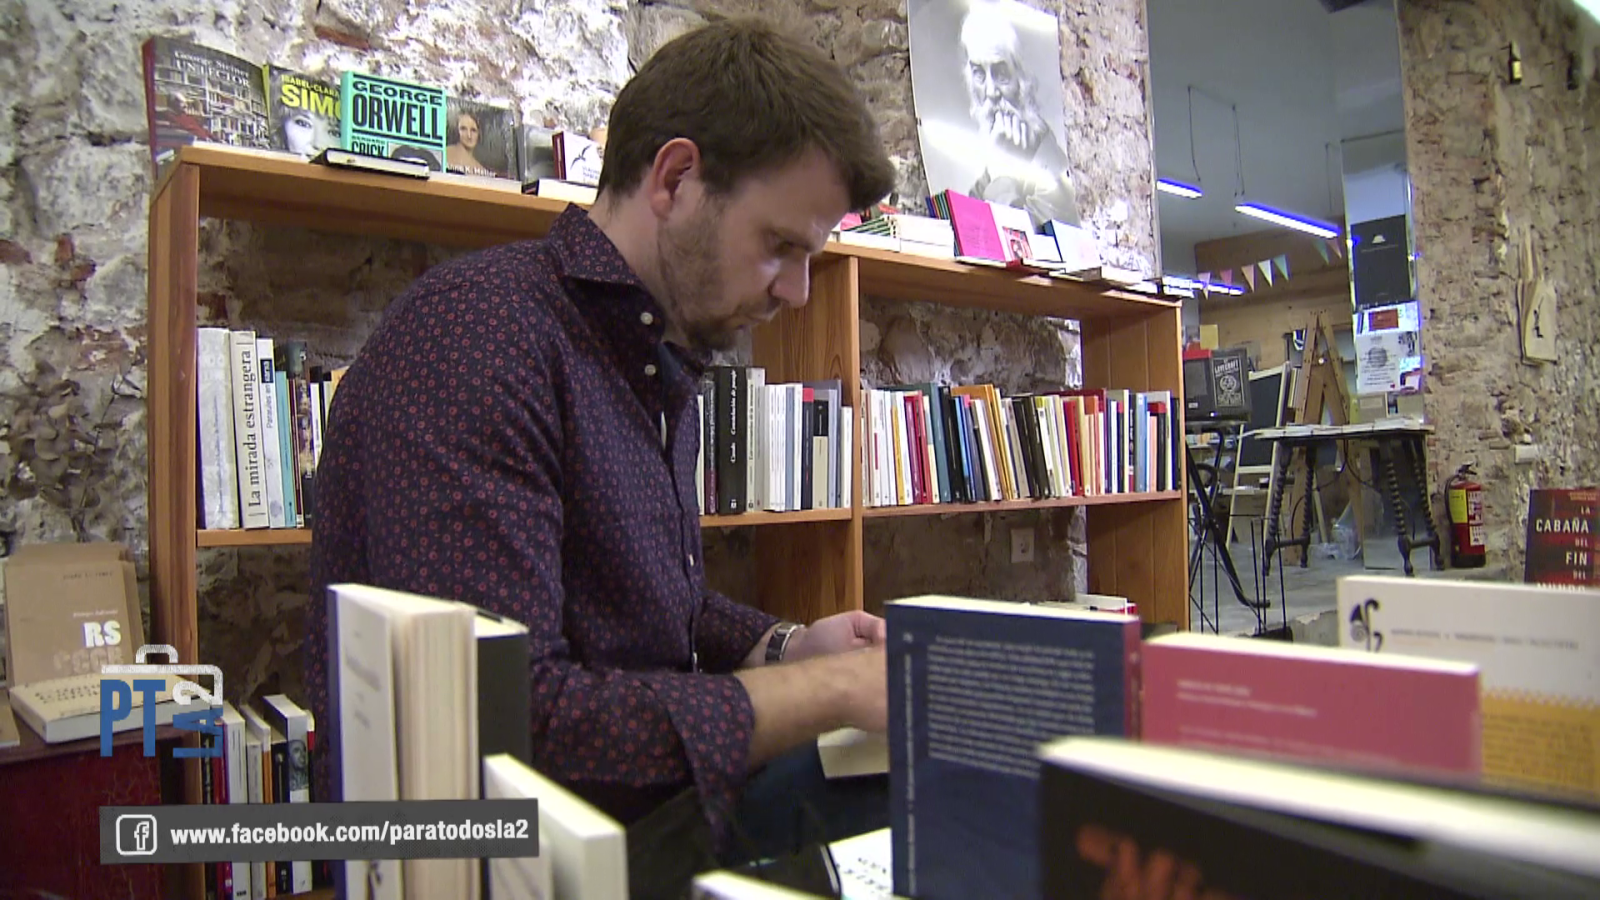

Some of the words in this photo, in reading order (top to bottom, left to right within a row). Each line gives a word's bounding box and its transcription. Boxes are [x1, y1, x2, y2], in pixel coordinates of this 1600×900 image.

[176, 60, 196, 71] UN
[200, 65, 250, 88] LECTOR
[216, 60, 249, 78] Steiner
[352, 80, 443, 107] GEORGE
[352, 93, 443, 141] ORWELL
[241, 350, 257, 428] estrangera
[242, 433, 258, 486] mirada
[248, 490, 261, 507] La
[1580, 506, 1590, 515] LA
[1535, 517, 1589, 533] CABAÑA
[1574, 538, 1588, 547] DEL
[1565, 551, 1587, 566] FIN
[1573, 570, 1586, 580] DEL
[83, 620, 121, 647] RS
